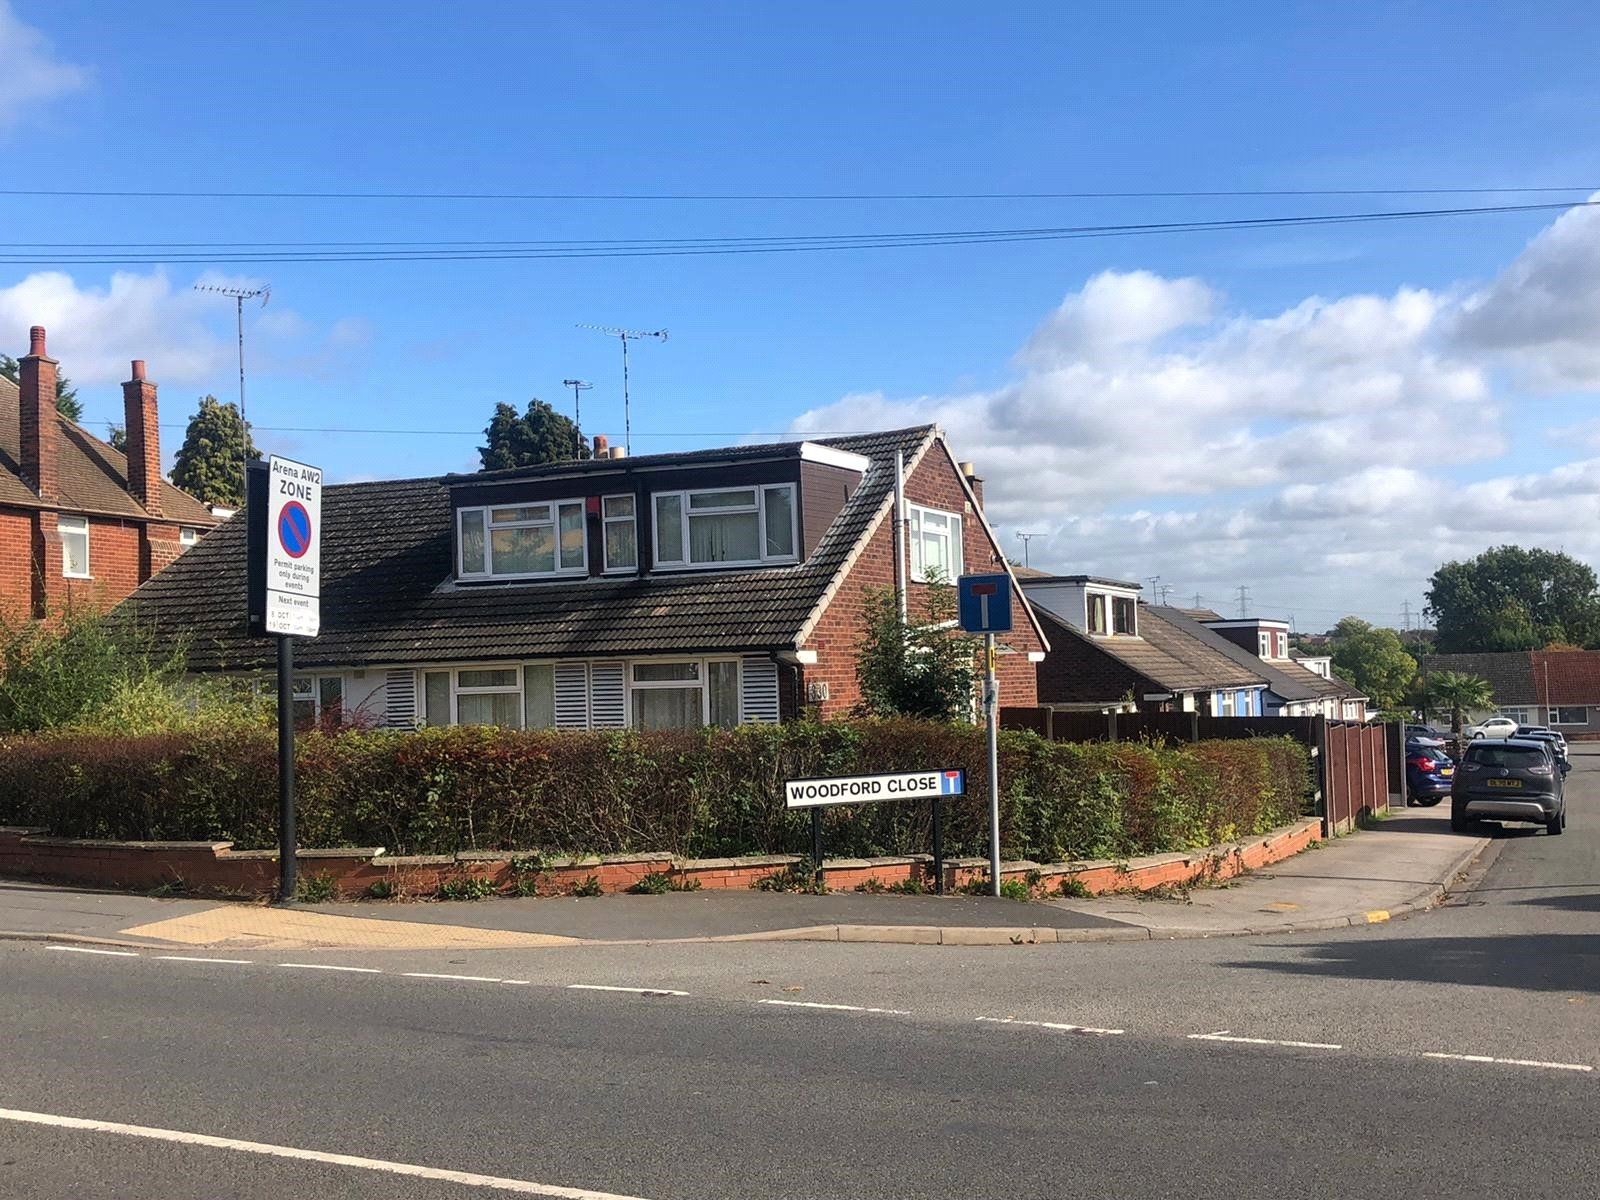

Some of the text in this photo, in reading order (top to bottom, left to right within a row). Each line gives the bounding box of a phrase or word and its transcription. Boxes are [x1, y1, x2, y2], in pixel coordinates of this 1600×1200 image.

[272, 460, 321, 485] Arena AW2
[280, 479, 312, 502] ZONE
[273, 558, 314, 575] Permit parking
[279, 570, 310, 584] only during
[285, 581, 304, 591] events
[278, 595, 309, 608] Next event
[790, 776, 937, 800] WOODFORD CLOSE
